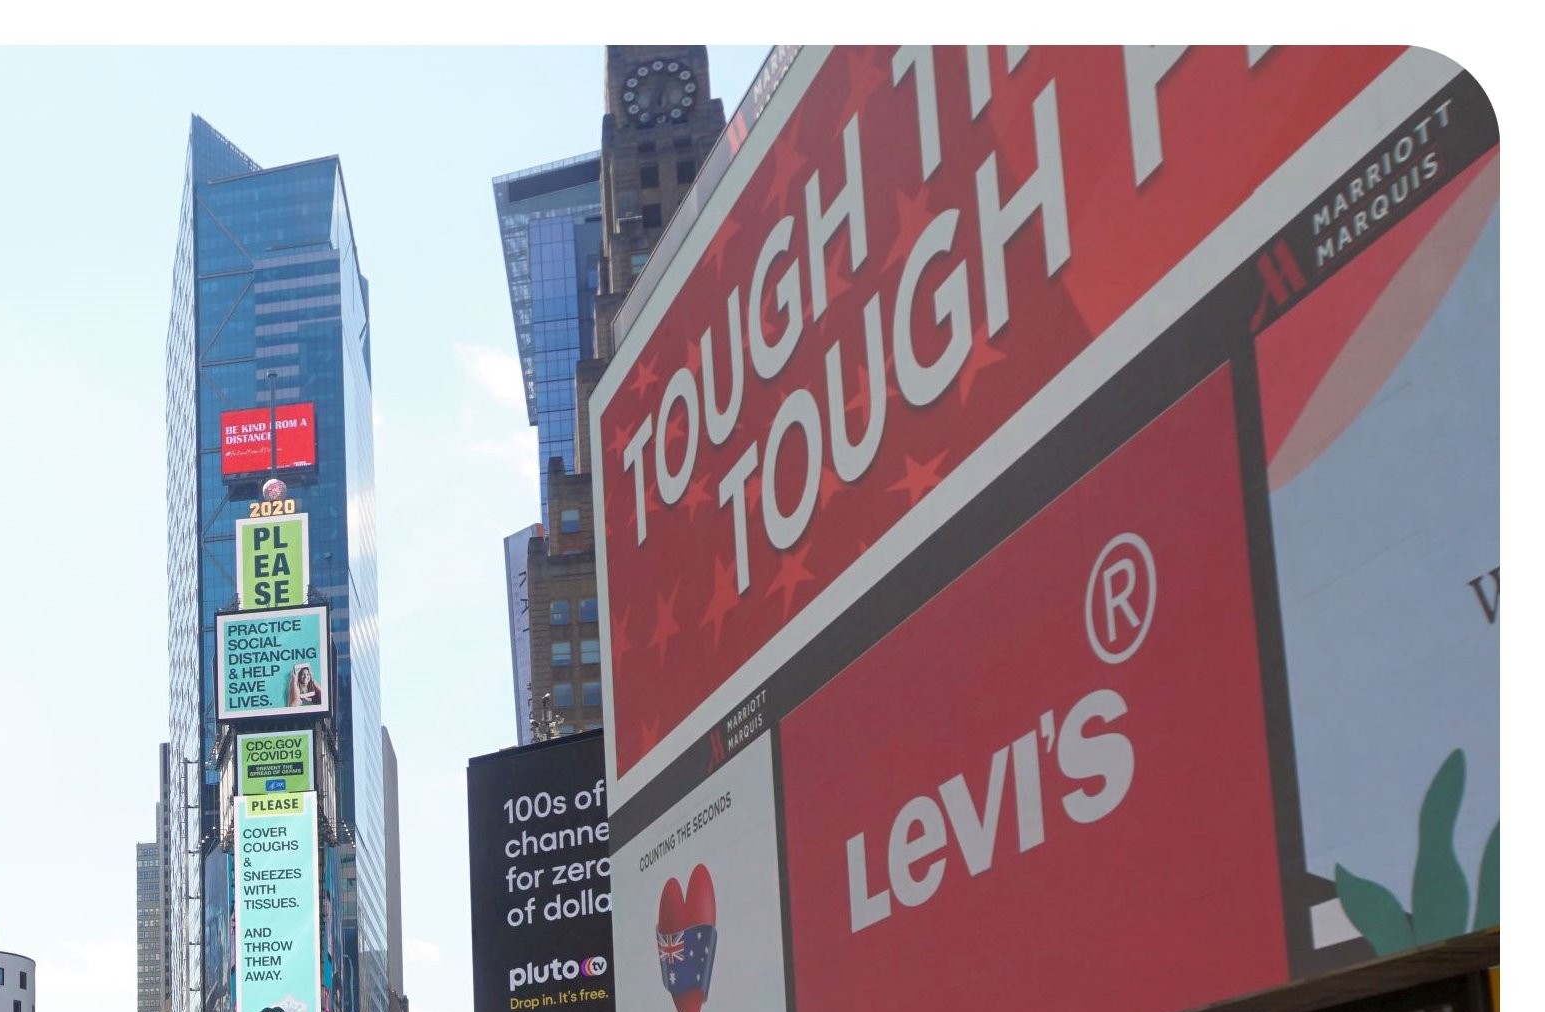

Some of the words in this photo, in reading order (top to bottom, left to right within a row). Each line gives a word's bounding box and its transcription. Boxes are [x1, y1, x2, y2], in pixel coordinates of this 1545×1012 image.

[1313, 99, 1452, 236] MARRIOTT
[1316, 152, 1439, 267] MARQUIS
[623, 111, 868, 547] TOUGH
[719, 77, 1072, 597] TOUGH
[225, 426, 239, 435] BE
[242, 422, 266, 433] KIND
[269, 419, 297, 431] ROM
[299, 418, 307, 427] A
[249, 499, 295, 518] 2020
[254, 527, 288, 550] PL
[255, 553, 291, 578] EA
[255, 580, 290, 606] SE
[228, 620, 302, 636] PRACTICE
[228, 636, 282, 651] SOCIAL
[228, 648, 317, 666] DISTANCING
[228, 669, 238, 679] &
[242, 665, 281, 679] HELP
[229, 682, 265, 694] SAVE
[229, 694, 273, 709] LIVES.
[726, 689, 767, 733] MARRIOTT
[728, 713, 763, 752] MARQUIS
[246, 738, 302, 752] CDC.GOV
[246, 749, 302, 763] /COVID19
[251, 798, 299, 812] PLEASE
[504, 792, 567, 824] 100s
[575, 779, 604, 810] of
[243, 826, 287, 839] COVER
[505, 822, 609, 858] channe
[639, 833, 676, 872] COUNTING
[676, 822, 692, 846] THE
[692, 791, 732, 833] SECONDS
[243, 841, 299, 853] COUGHS
[243, 858, 252, 867] &
[243, 869, 302, 882] SNEEZES
[506, 866, 544, 893] for
[552, 857, 610, 885] zero
[244, 884, 276, 896] WITH
[244, 898, 300, 910] TISSUES.
[507, 898, 536, 927] of
[244, 927, 272, 939] AND
[245, 941, 293, 953] THROW
[245, 956, 282, 967] THEM
[245, 970, 283, 982] AWAY.
[509, 958, 580, 992] pluto
[592, 960, 605, 972] tv
[510, 995, 540, 1011] Drop
[542, 993, 557, 1006] in.
[559, 990, 577, 1004] It's
[580, 988, 609, 1000] free.
